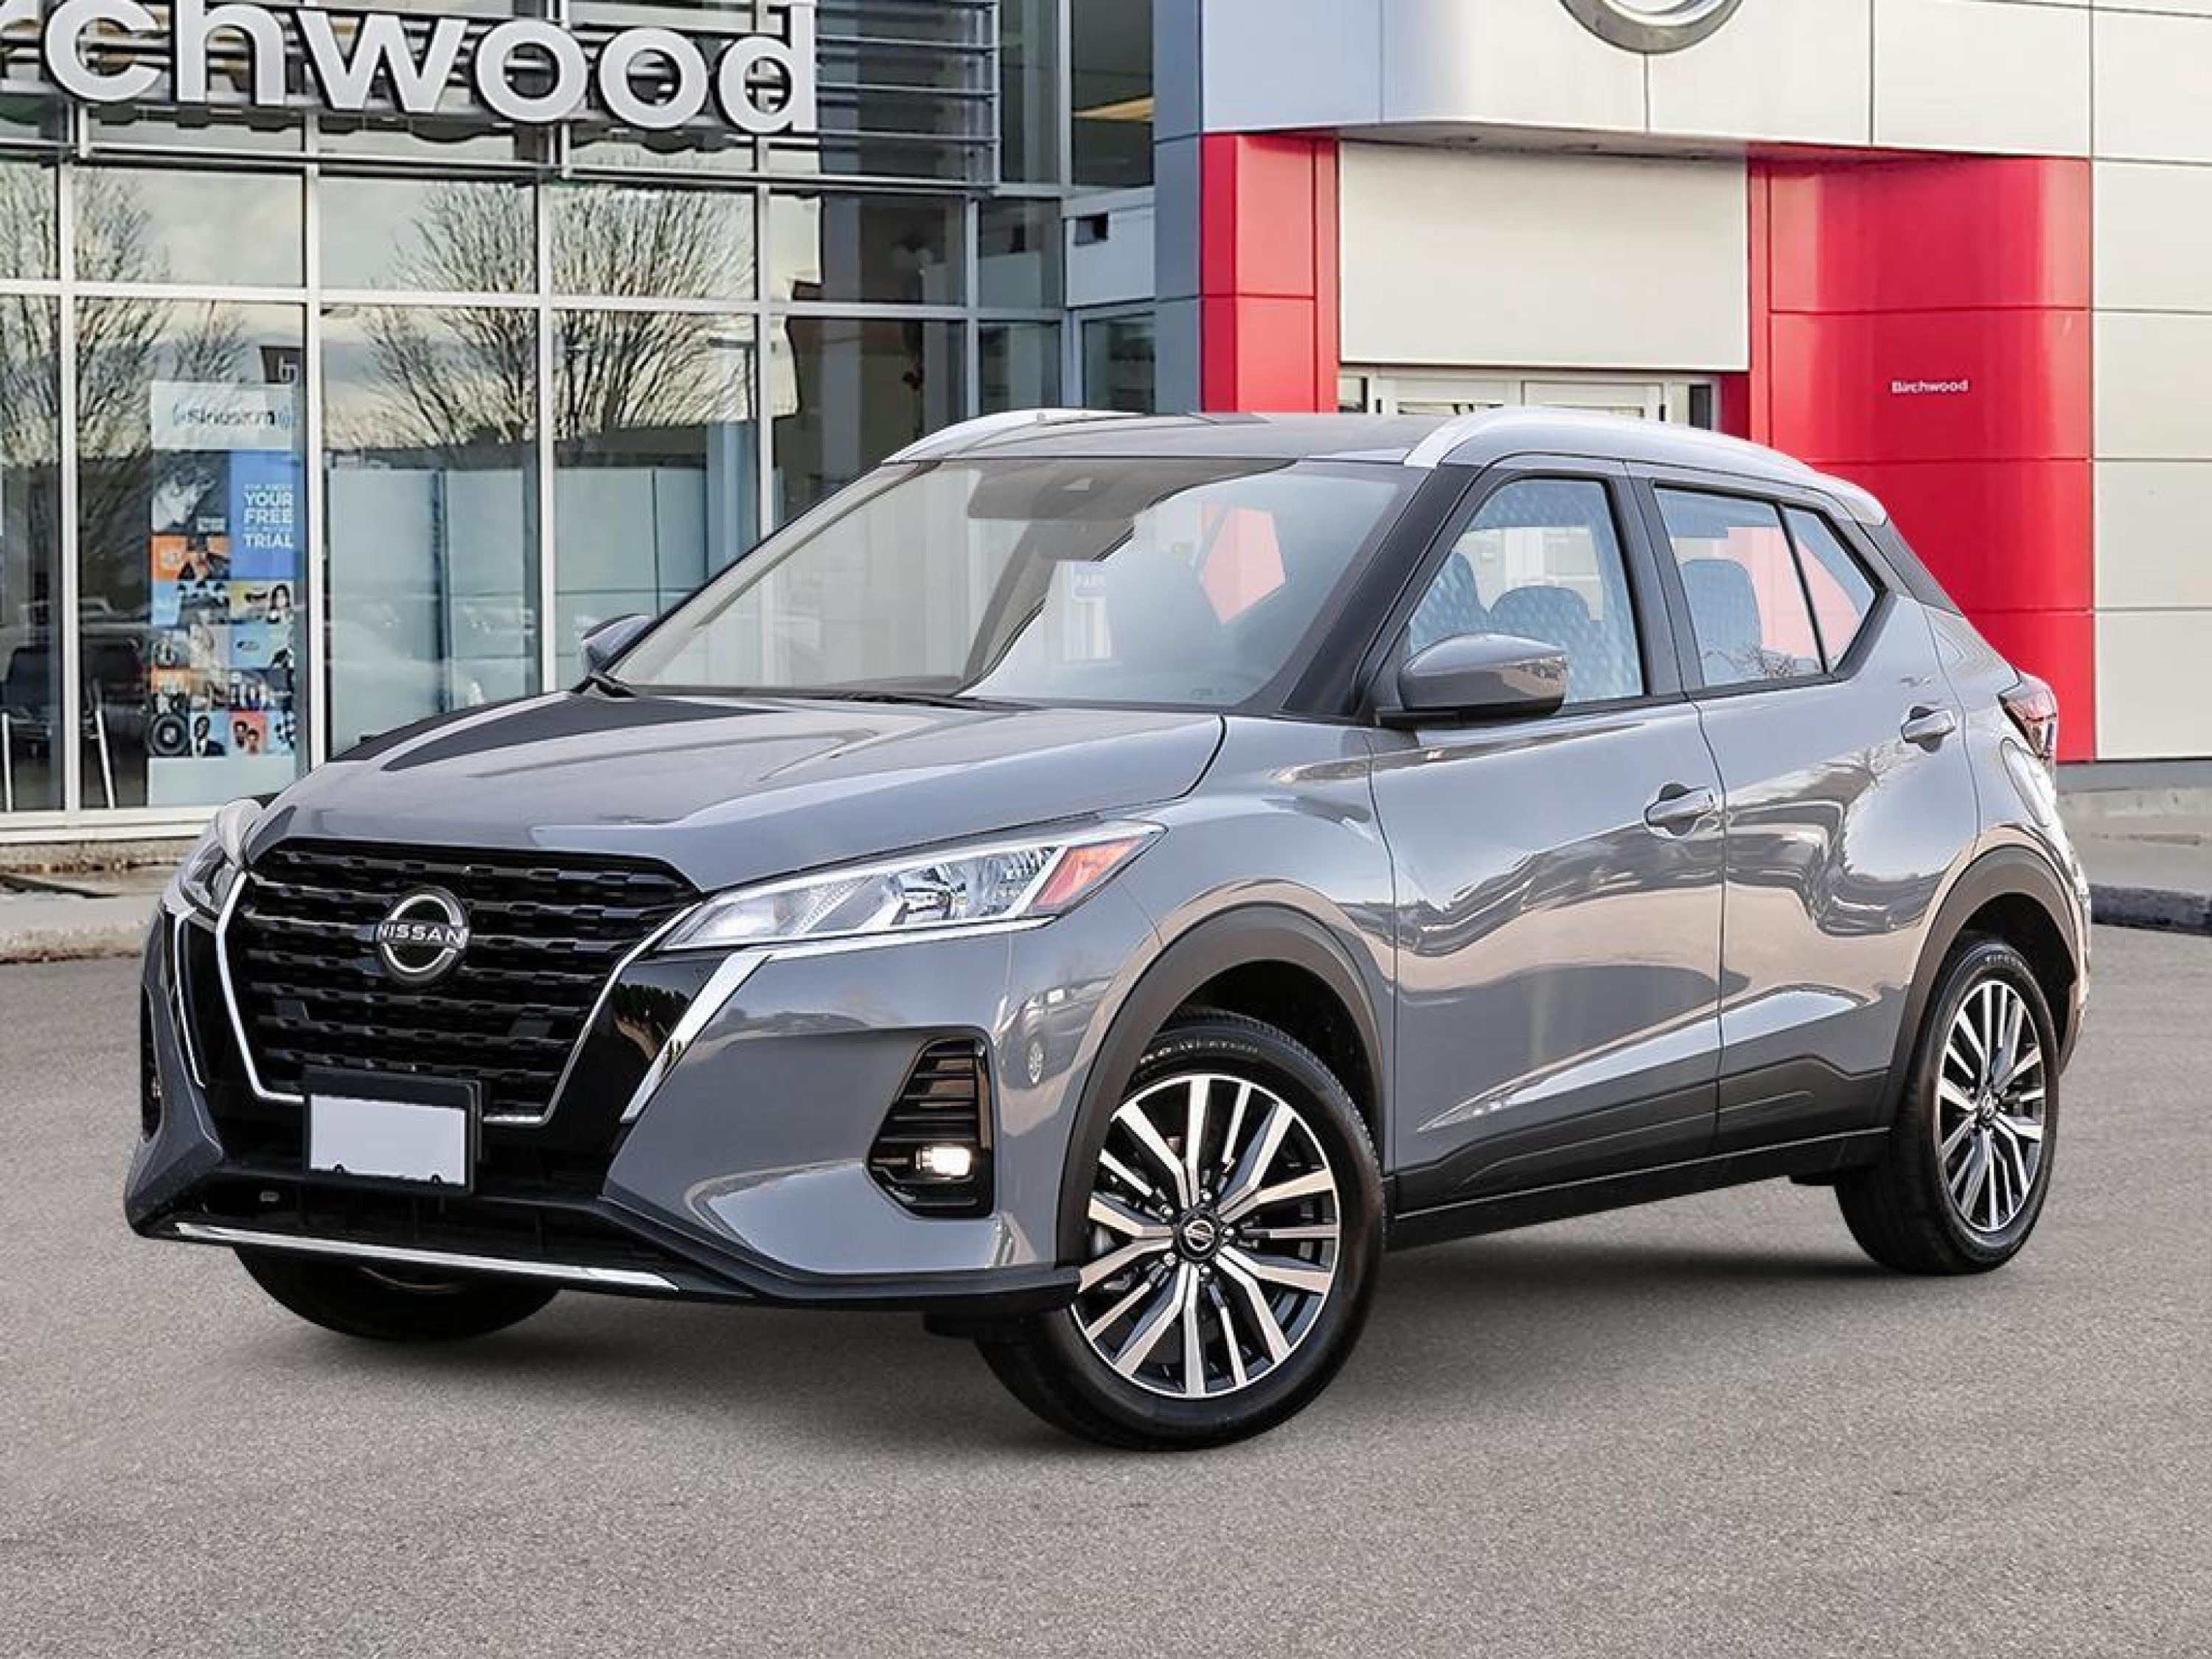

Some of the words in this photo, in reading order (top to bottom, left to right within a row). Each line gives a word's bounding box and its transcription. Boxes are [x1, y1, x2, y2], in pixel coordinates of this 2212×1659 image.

[1891, 379, 1968, 393] Birchwood
[244, 492, 293, 507] YOUR
[244, 508, 293, 523] FREE
[243, 534, 293, 549] TRIAL
[377, 923, 470, 950] NISSAN
